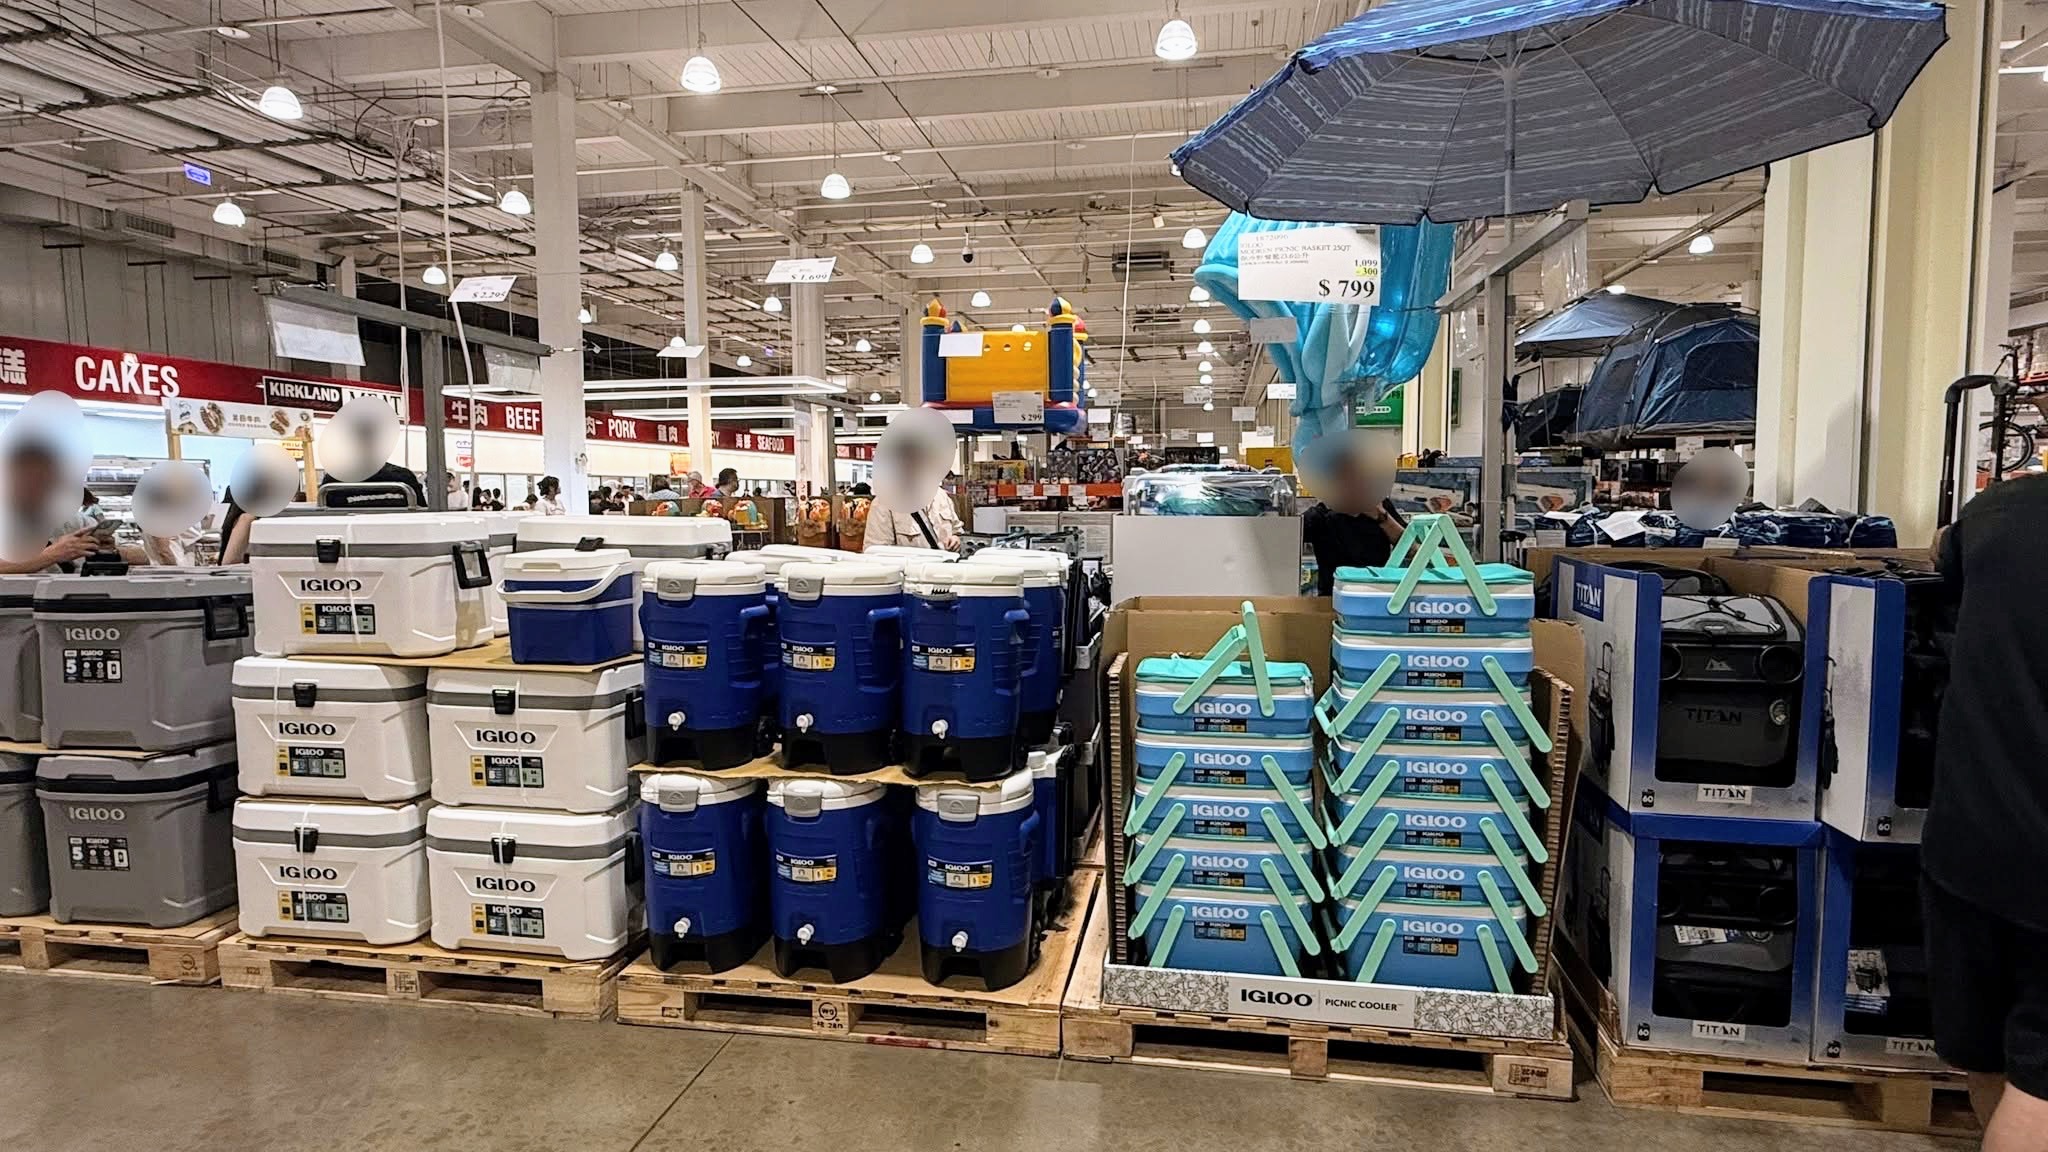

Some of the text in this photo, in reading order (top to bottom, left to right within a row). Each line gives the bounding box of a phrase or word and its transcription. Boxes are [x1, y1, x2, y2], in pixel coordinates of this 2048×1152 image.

[1318, 279, 1375, 298] $ 799
[75, 356, 180, 398] CAKES
[269, 382, 340, 402] KIRKLAND
[452, 401, 488, 426] 牛肉
[506, 406, 540, 430] BEEF
[608, 418, 636, 439] PORK
[757, 436, 784, 452] SEAFOOD
[301, 579, 362, 591] IGLOO
[1410, 602, 1471, 614] IGLOO
[65, 628, 120, 641] IGLOO
[66, 659, 77, 673] 5
[1408, 655, 1469, 668] IGLOO
[1194, 702, 1251, 715] IGLOO
[1406, 708, 1467, 722] IGLOO
[1684, 708, 1742, 722] TITAN
[279, 722, 336, 735] IGLOO
[477, 730, 536, 744] IGLOO
[1194, 752, 1251, 766] IGLOO
[1406, 761, 1468, 774] IGLOO
[1703, 788, 1746, 798] TITAN
[69, 807, 125, 820] IGLOO
[1192, 804, 1249, 818] IGLOO
[1406, 814, 1466, 828] IGLOO
[73, 847, 83, 860] 5
[1192, 856, 1249, 869] IGLOO
[1404, 867, 1465, 881] IGLOO
[476, 877, 536, 892] IGLOO
[1192, 906, 1249, 919] IGLOO
[1403, 920, 1464, 934] IGLOO
[1241, 989, 1397, 1011] IGLOO PICNIC COOLER
[1697, 1024, 1740, 1035] TITAN
